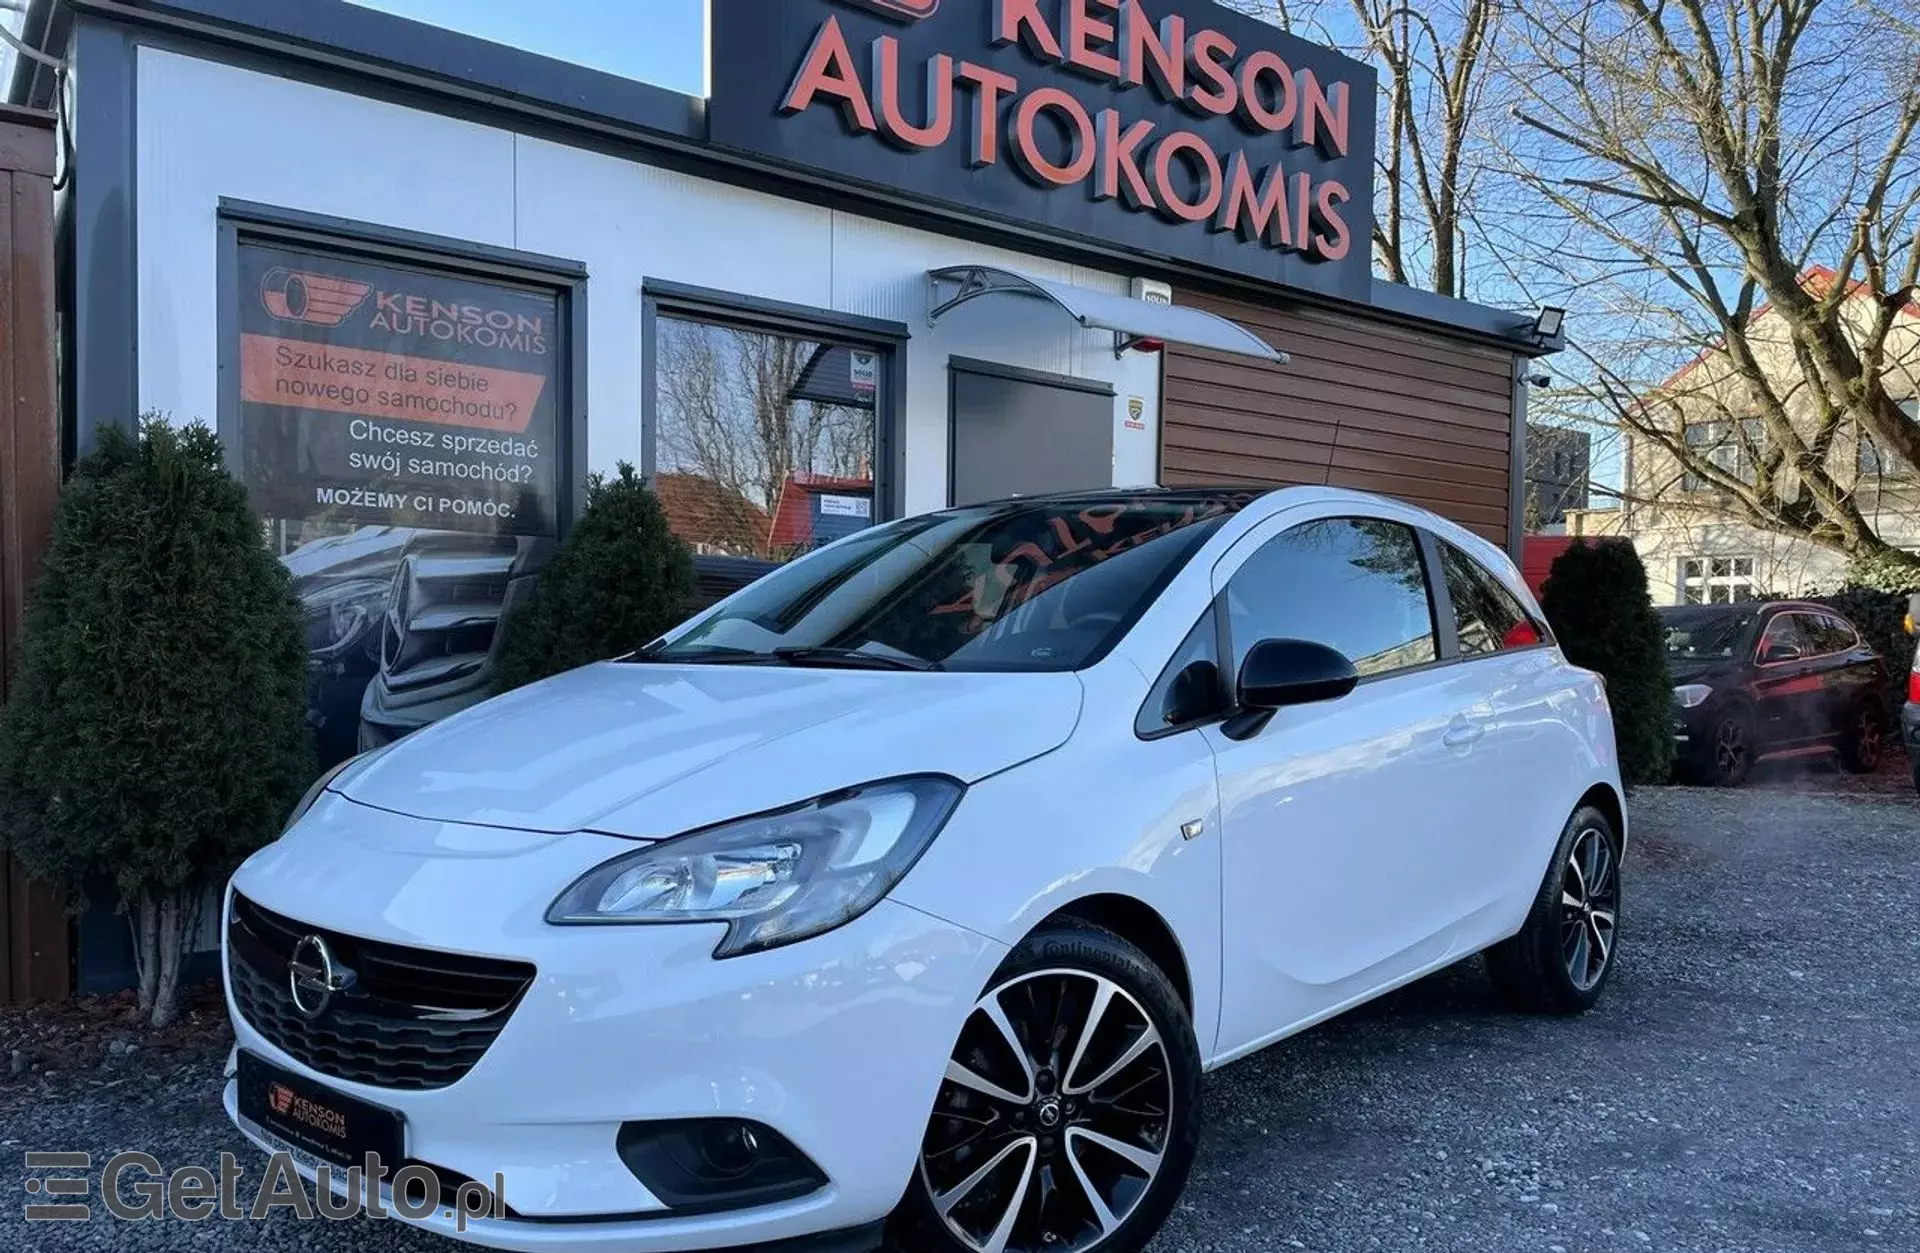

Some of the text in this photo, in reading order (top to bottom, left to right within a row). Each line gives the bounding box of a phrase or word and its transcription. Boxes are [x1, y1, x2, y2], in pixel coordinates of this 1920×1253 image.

[782, 14, 1350, 260] AUTOKOMIS
[369, 311, 546, 355] AUTOKOMIS
[376, 291, 542, 334] KENSON
[276, 345, 489, 392] Szukasz dla siebie
[276, 377, 518, 421] nowego samochodu?
[350, 419, 539, 459] Chcesz sprzedać
[349, 451, 533, 484] swój samochód?
[316, 487, 516, 518] MOŻEMY CI POMÓC.
[292, 1108, 347, 1139] AUTOKOMIS
[293, 1097, 345, 1125] KENSON
